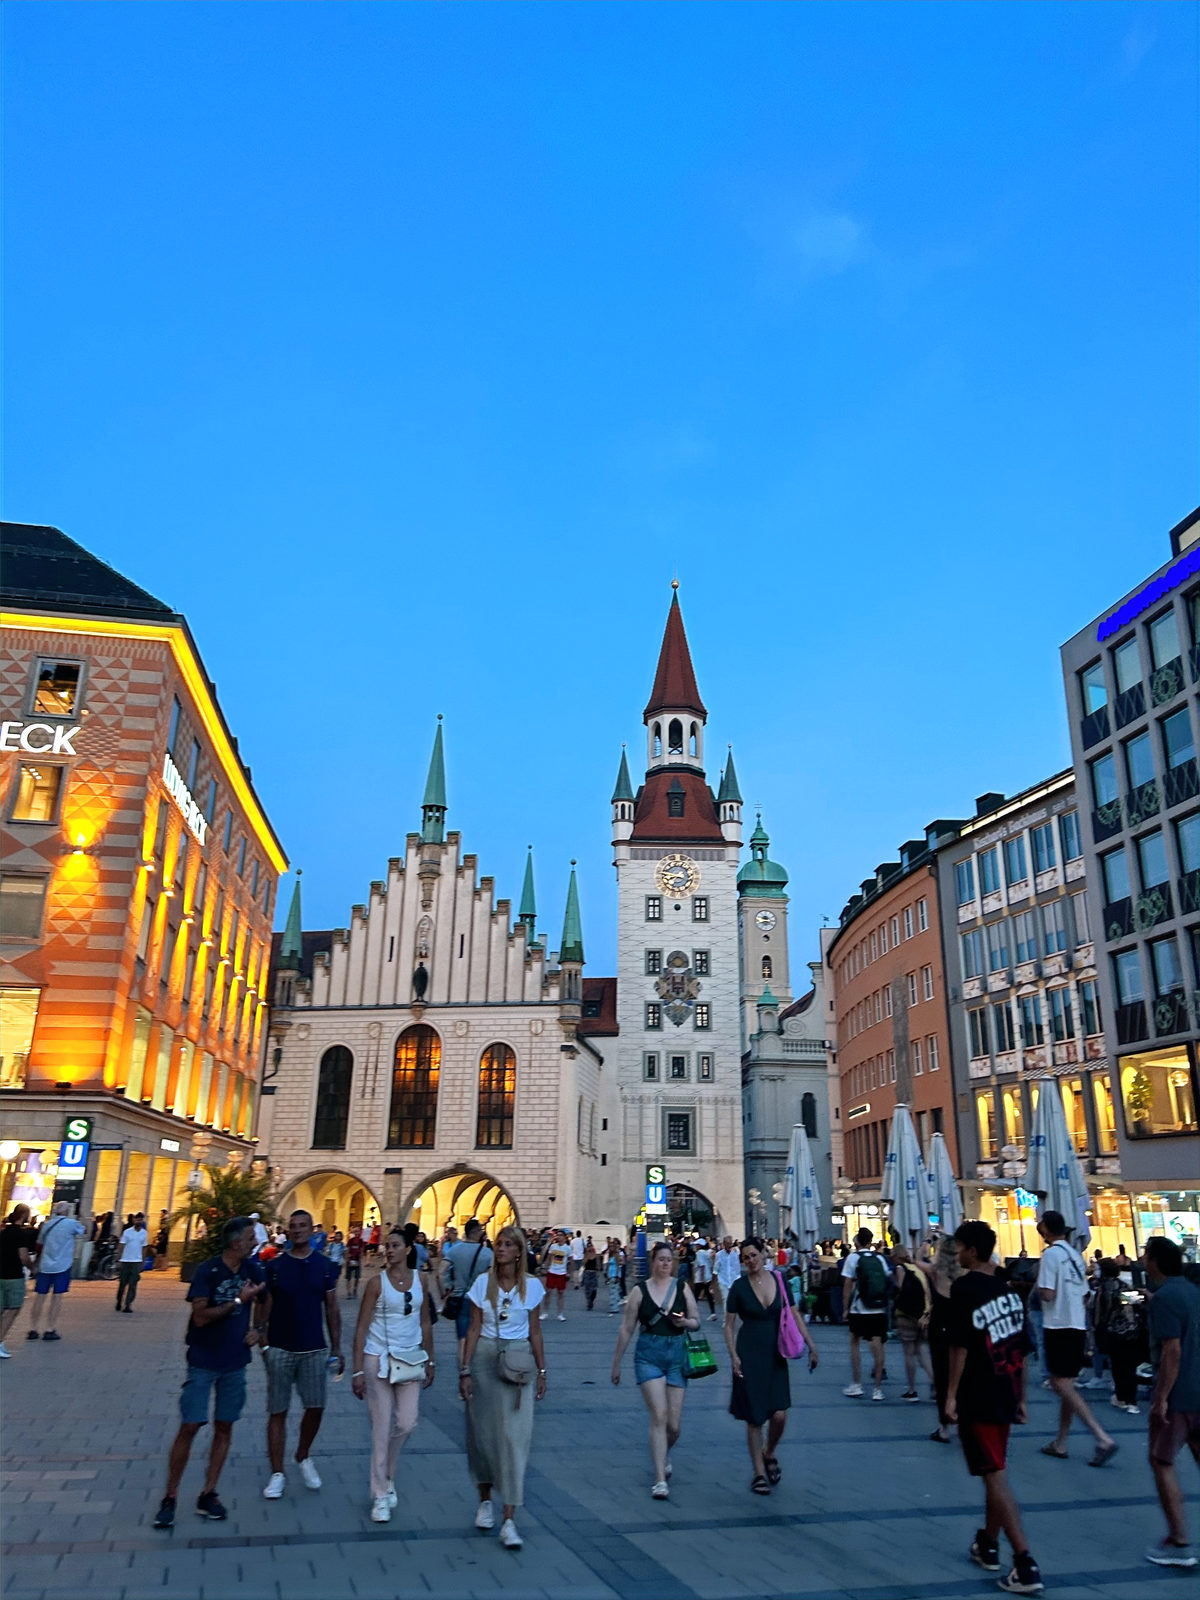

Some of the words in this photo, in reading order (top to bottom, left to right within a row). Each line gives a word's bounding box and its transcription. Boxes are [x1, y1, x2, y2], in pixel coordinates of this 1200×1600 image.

[67, 1119, 88, 1140] S
[64, 1144, 84, 1165] U
[648, 1166, 664, 1184] S
[648, 1186, 662, 1202] U
